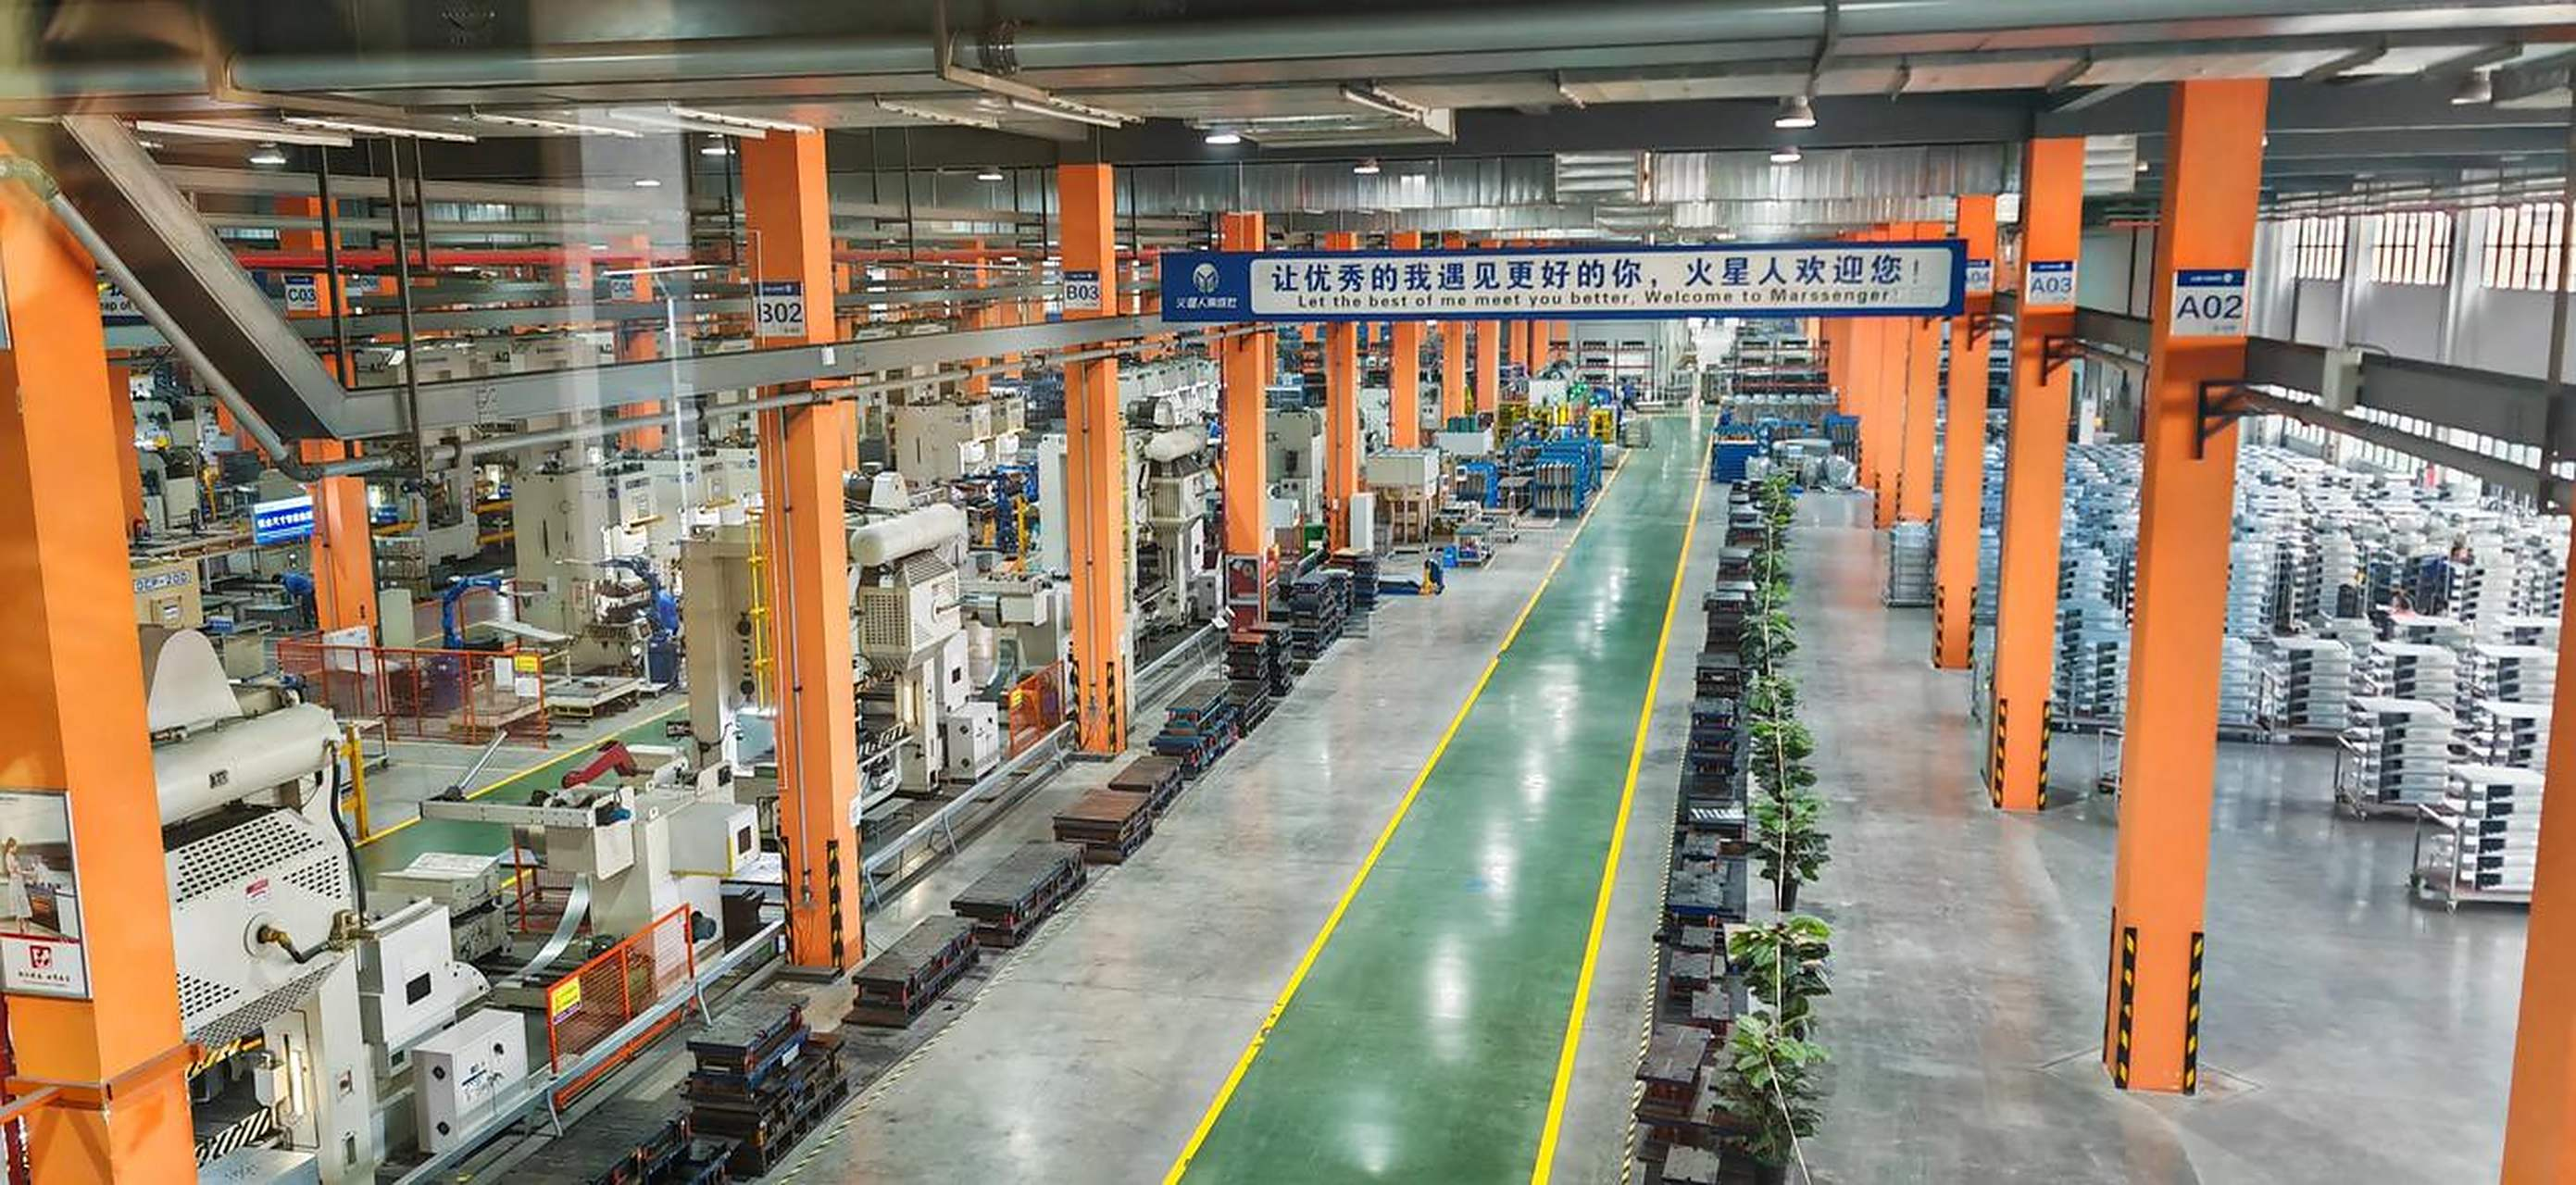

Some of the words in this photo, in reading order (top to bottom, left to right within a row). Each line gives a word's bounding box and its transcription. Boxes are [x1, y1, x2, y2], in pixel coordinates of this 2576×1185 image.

[1067, 285, 1098, 300] B03
[2032, 278, 2071, 293] A03
[288, 288, 317, 302] C03
[1299, 295, 1324, 307] Let
[1333, 294, 1361, 307] the
[1369, 294, 1407, 307] best
[1416, 294, 1432, 306] of
[1441, 296, 1466, 306] me
[1475, 294, 1519, 306] meet
[1529, 294, 1561, 308] you
[1644, 291, 1732, 304] Welcome
[1743, 291, 1761, 303] to
[757, 303, 803, 322] B02
[2177, 294, 2243, 319] A02
